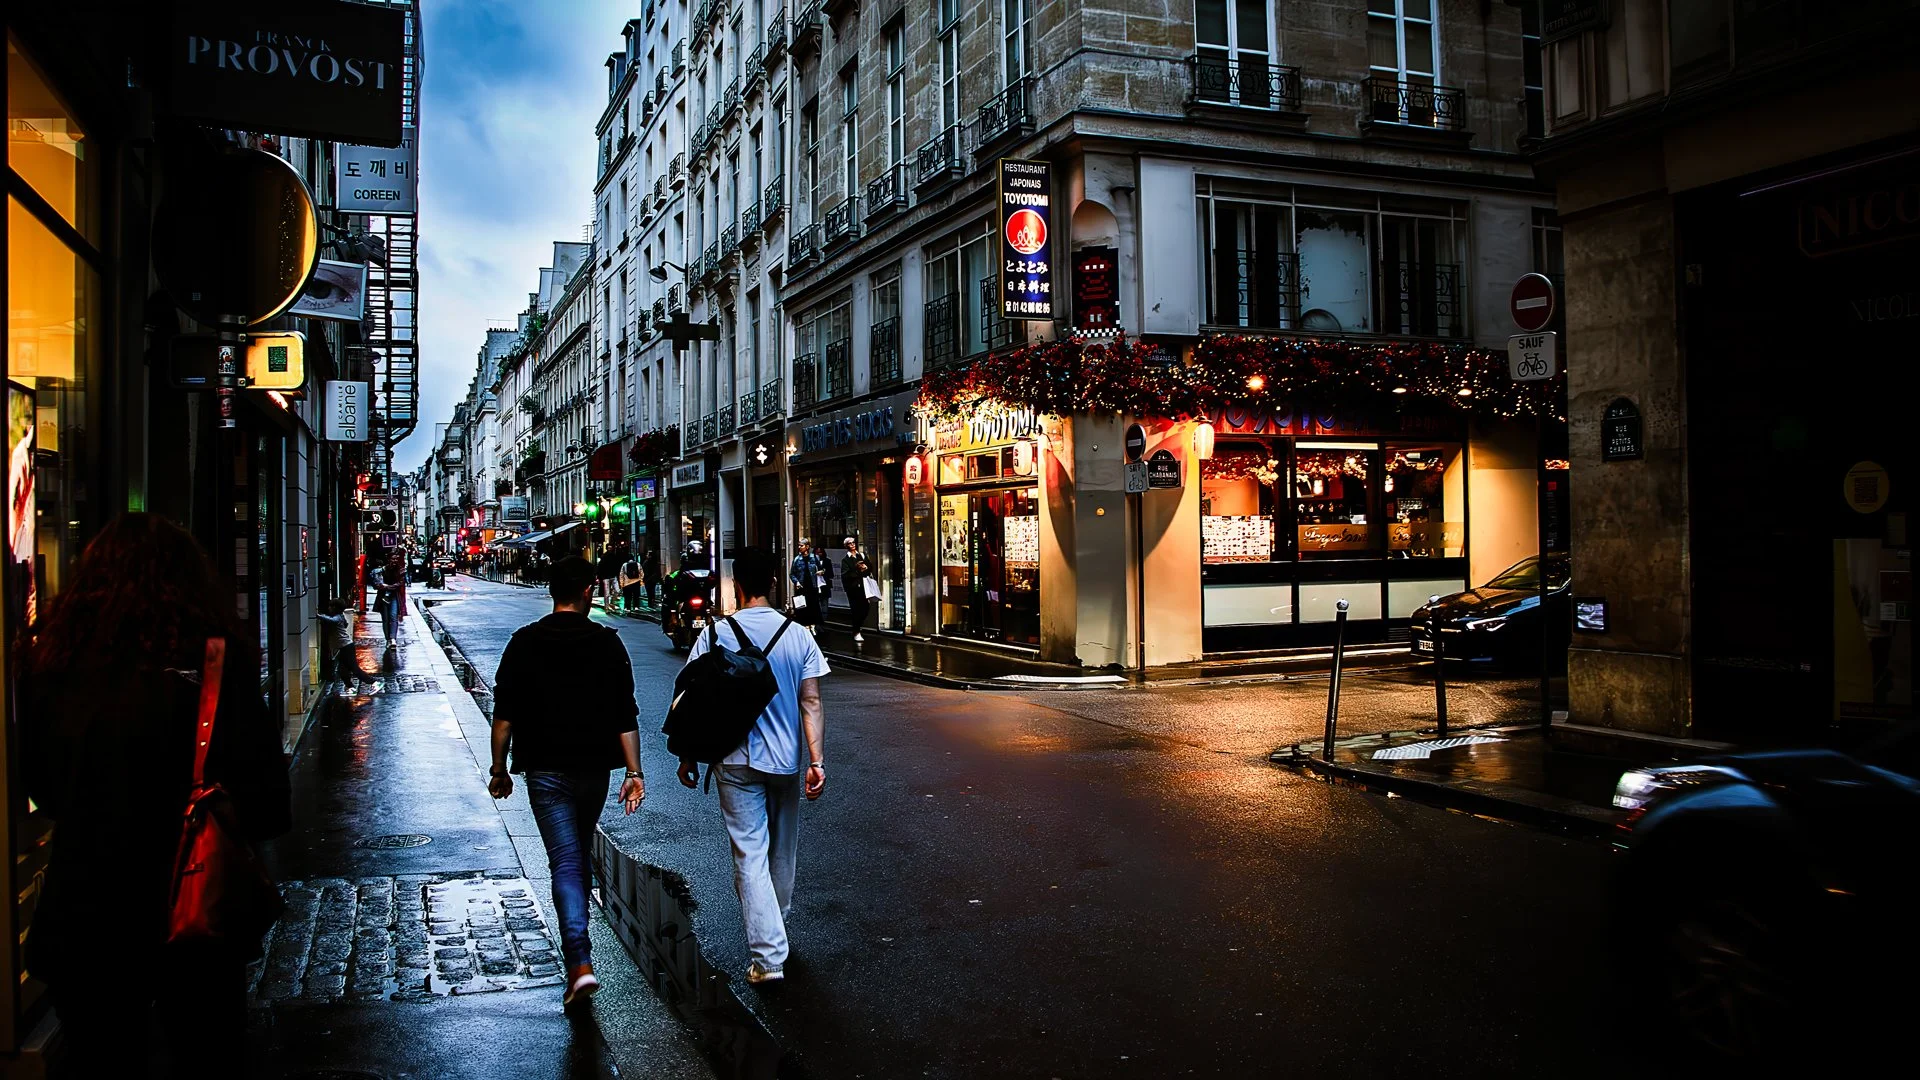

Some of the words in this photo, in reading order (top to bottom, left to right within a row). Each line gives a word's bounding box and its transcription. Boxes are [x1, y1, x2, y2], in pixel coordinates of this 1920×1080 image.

[255, 29, 332, 52] FRANCK
[187, 34, 394, 91] PROVOST
[344, 159, 409, 180] 도깨비
[1004, 163, 1046, 174] RESTAURANT
[1009, 178, 1041, 189] JAPONAIS
[353, 189, 401, 201] COREEN
[1004, 192, 1048, 207] TOYOTOMI
[1005, 260, 1048, 275] とよとみ
[1007, 279, 1050, 294] 日本料理
[1518, 336, 1544, 349] SAUF
[338, 384, 356, 439] albane
